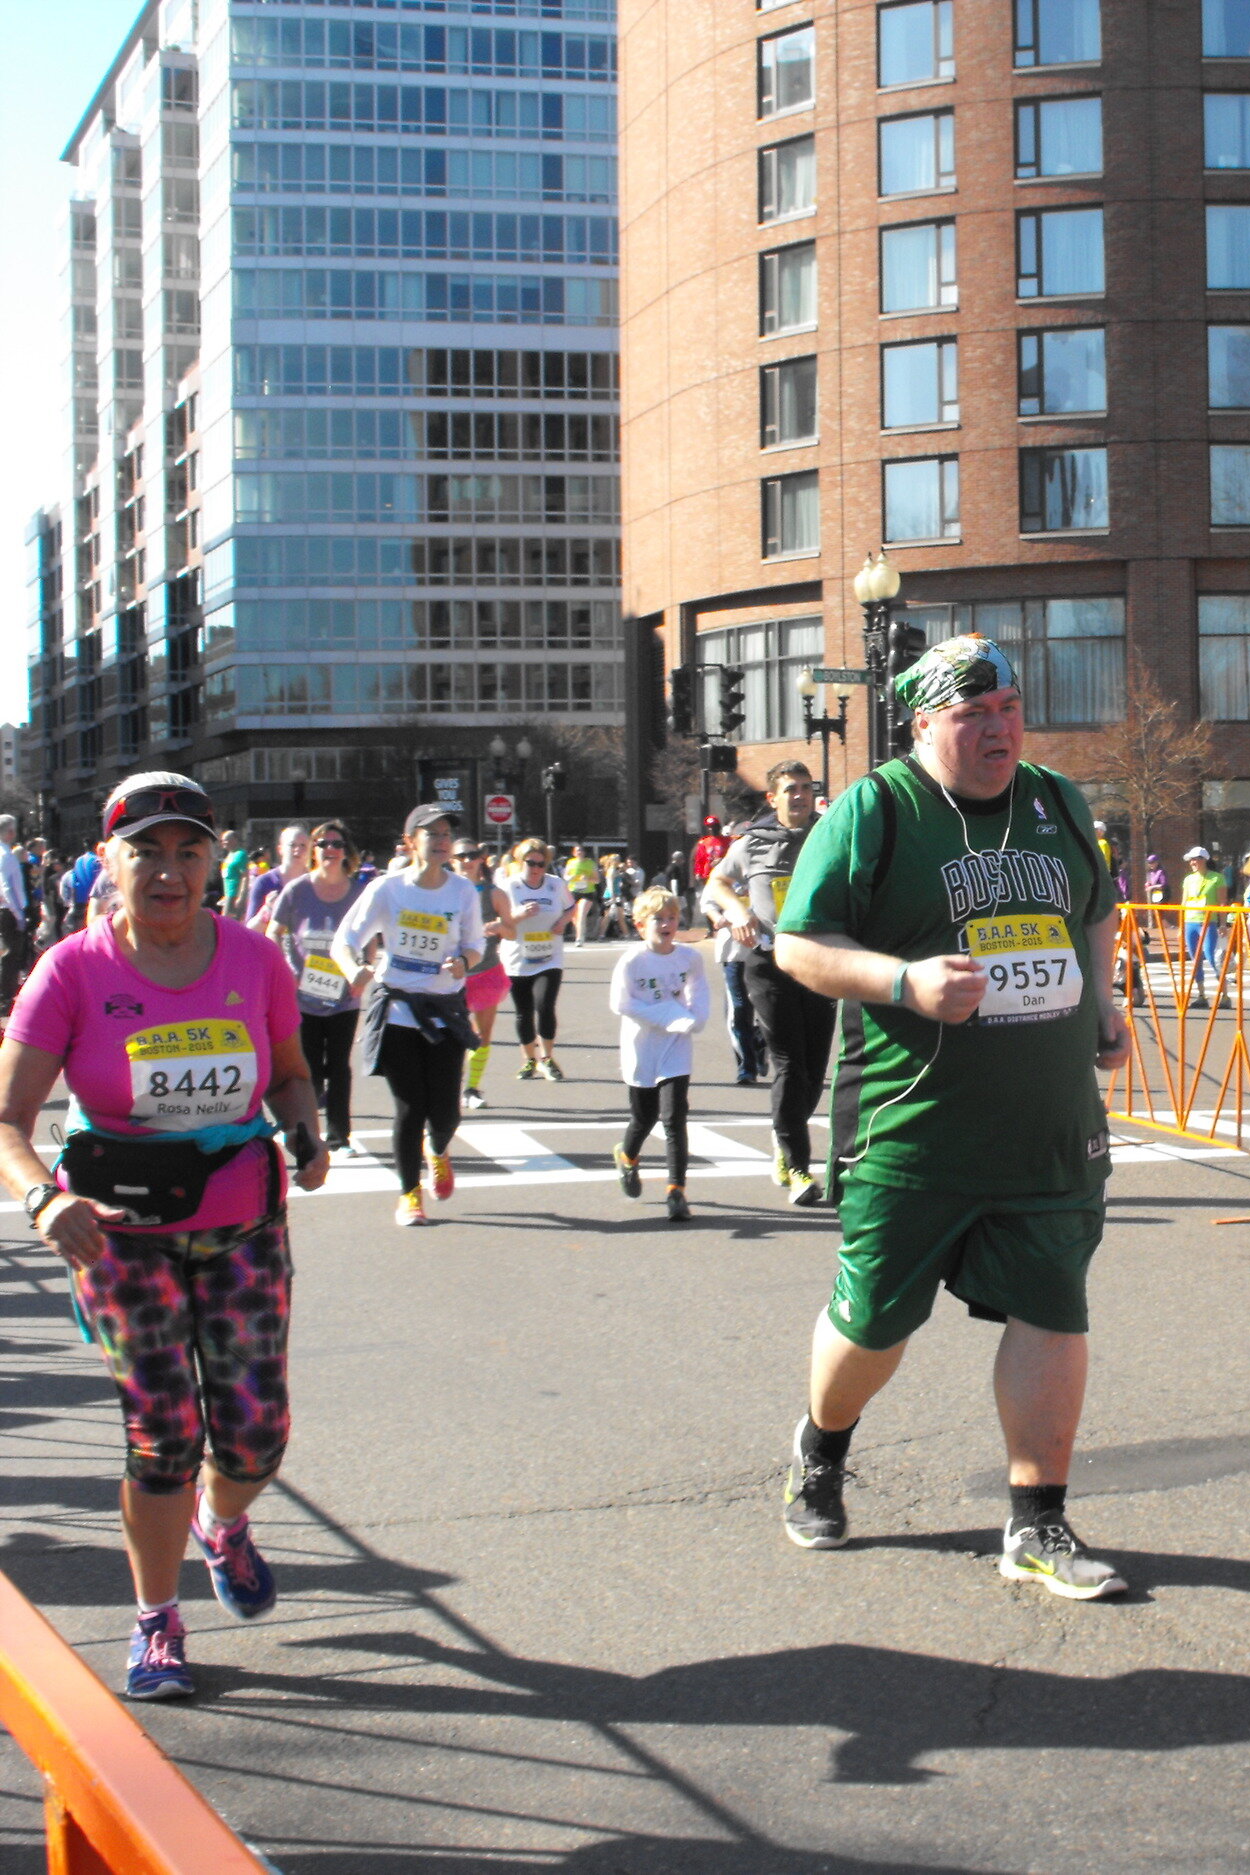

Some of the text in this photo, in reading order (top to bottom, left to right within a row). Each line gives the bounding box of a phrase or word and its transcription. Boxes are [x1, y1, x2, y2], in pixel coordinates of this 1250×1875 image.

[940, 849, 1071, 922] BOSTON
[977, 923, 1040, 941] B.A.A. 5K
[399, 932, 440, 951] 3135
[307, 973, 340, 990] 9444
[989, 958, 1067, 992] 9557
[1023, 995, 1045, 1006] Dan
[186, 1027, 210, 1041] 5K
[149, 1065, 241, 1098] 8442
[157, 1101, 231, 1114] Rosa Nelly
